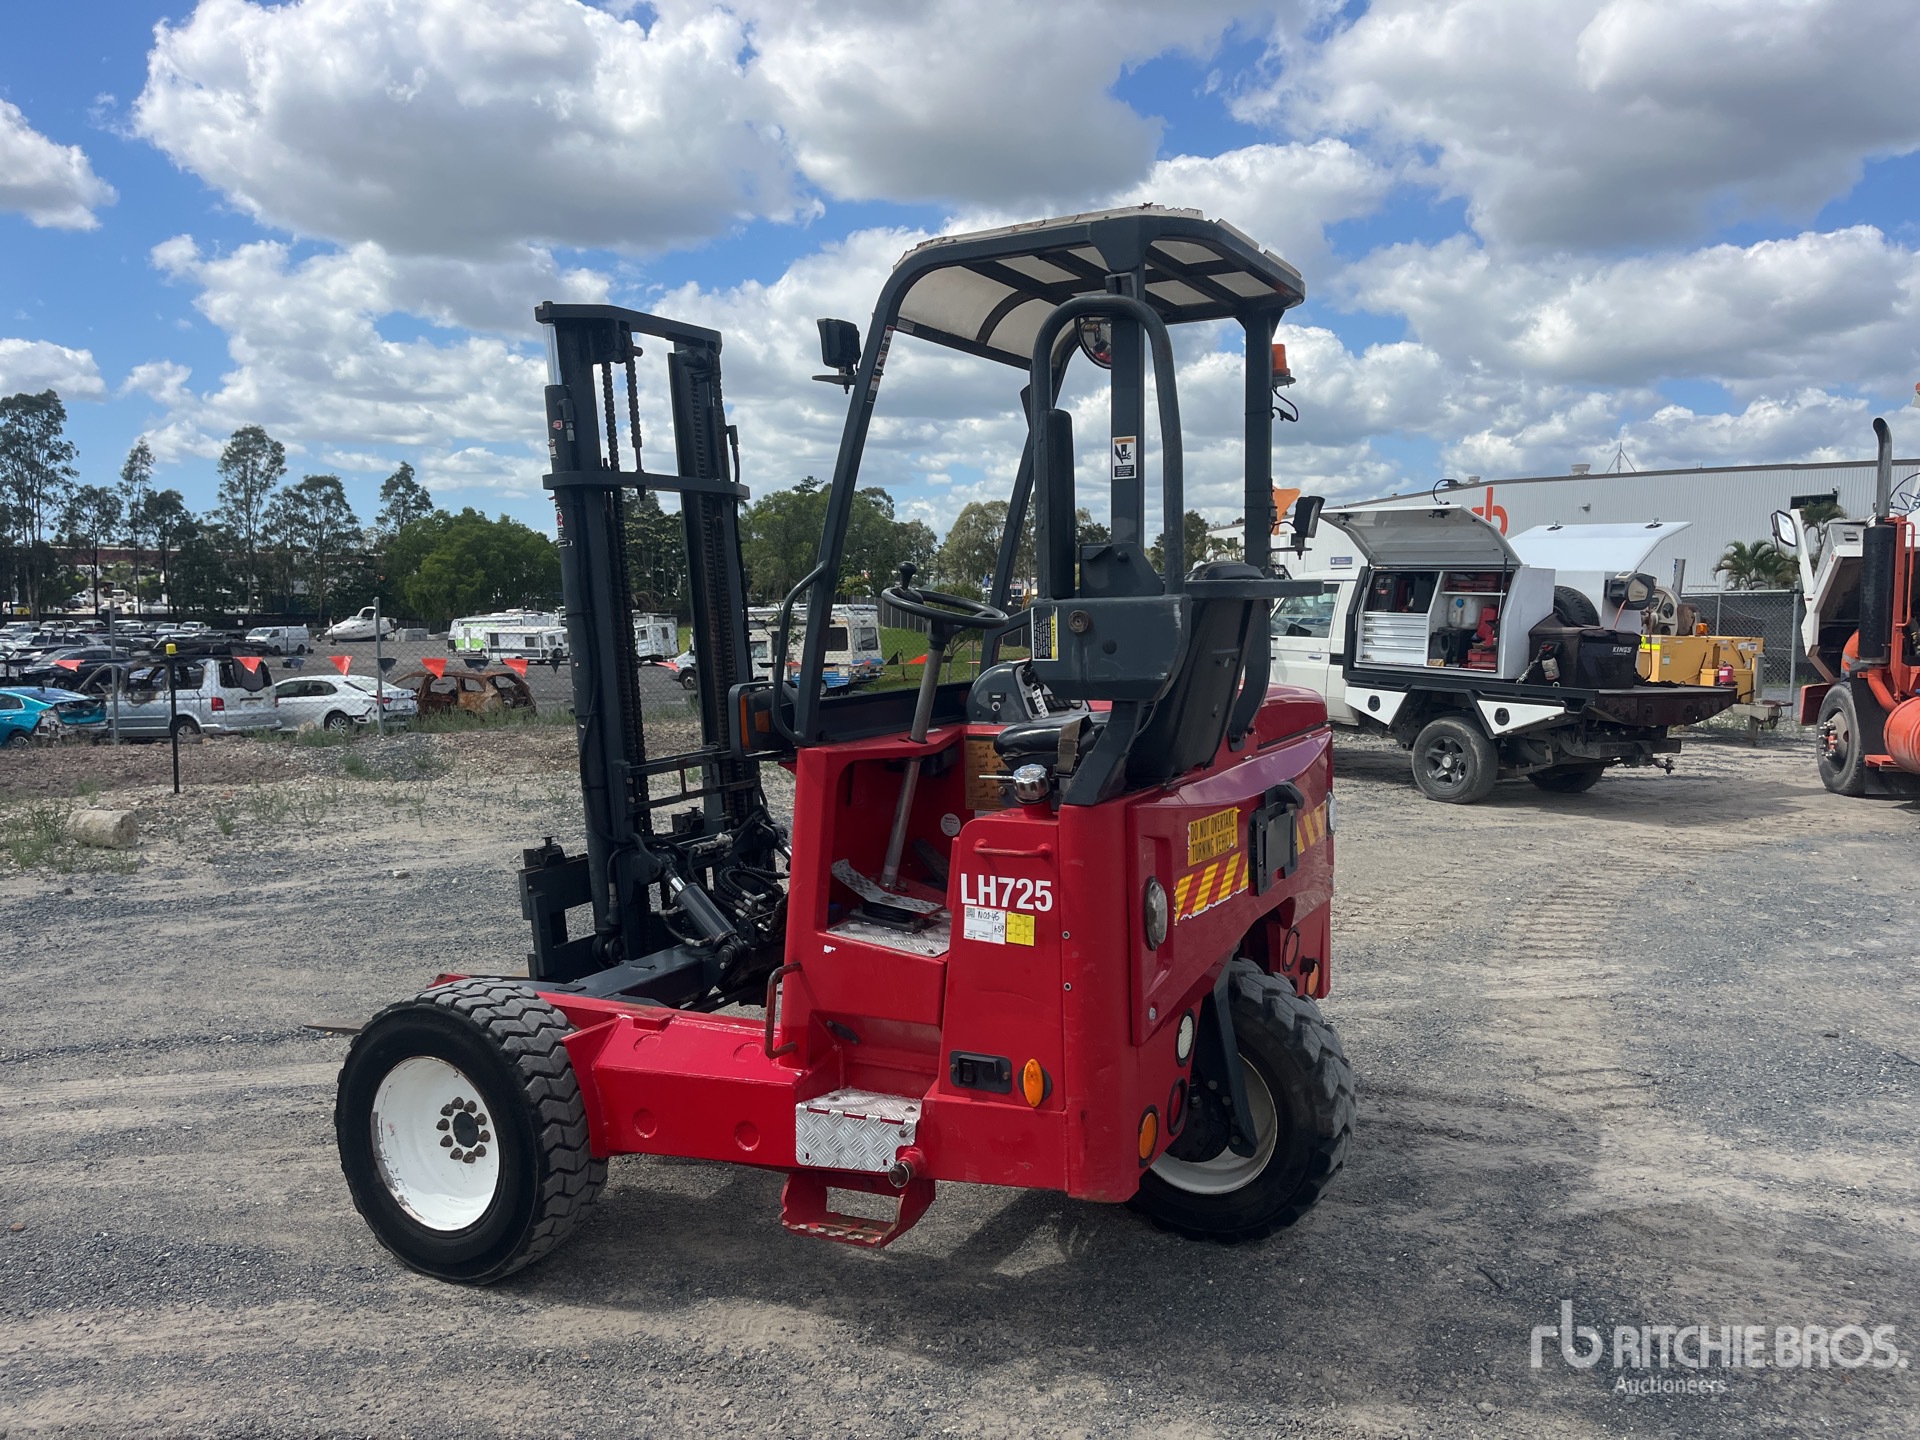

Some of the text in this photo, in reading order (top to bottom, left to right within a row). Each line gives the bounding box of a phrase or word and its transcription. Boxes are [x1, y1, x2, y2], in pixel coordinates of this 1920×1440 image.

[1191, 810, 1234, 842] DO NOT OVERTAKE
[1192, 837, 1214, 862] TURNING
[961, 873, 1053, 912] LH725
